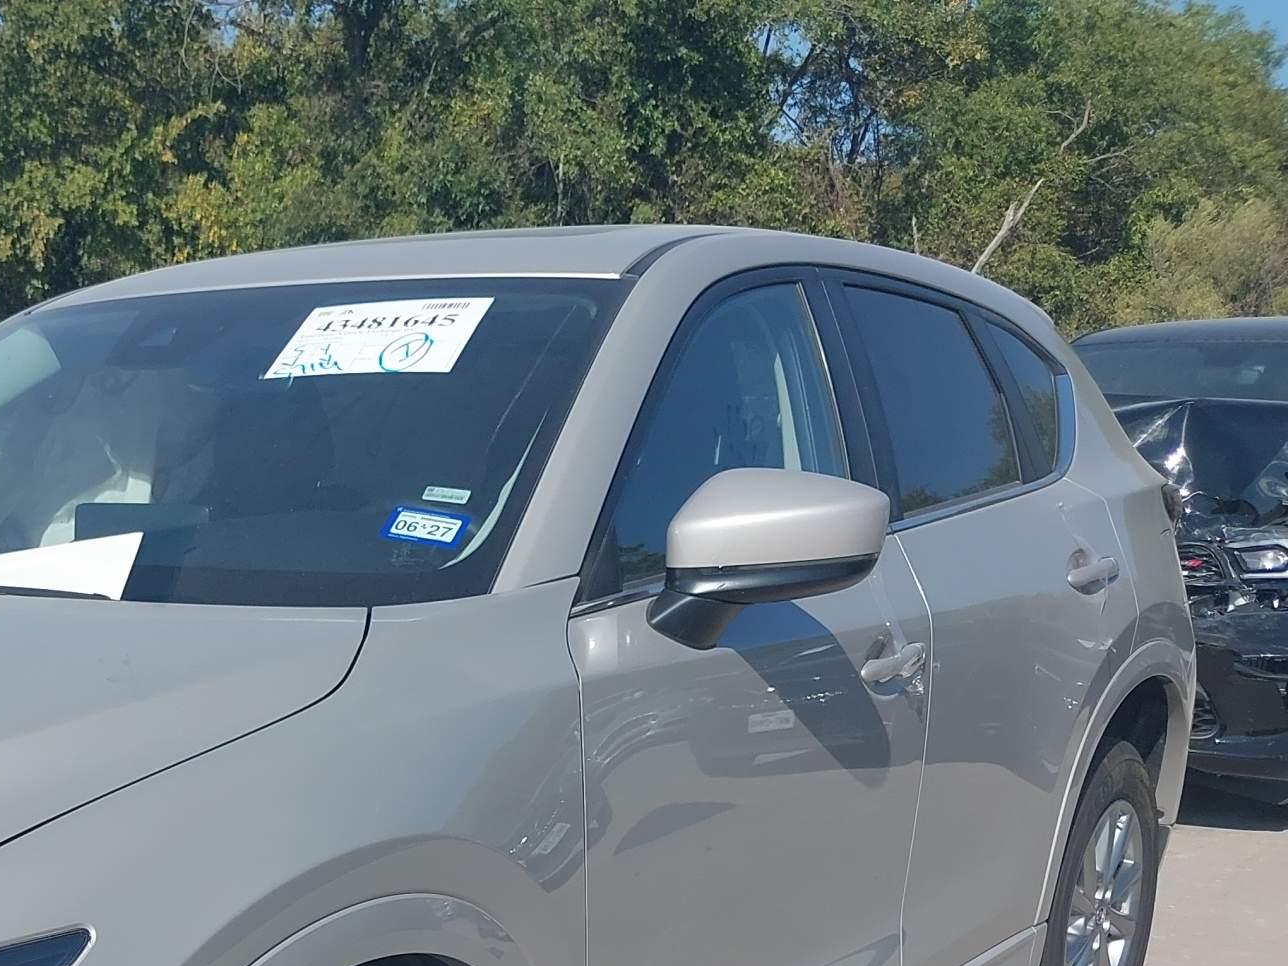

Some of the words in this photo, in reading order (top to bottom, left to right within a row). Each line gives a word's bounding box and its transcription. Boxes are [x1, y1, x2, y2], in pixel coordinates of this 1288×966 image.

[316, 314, 459, 332] 43481645
[395, 520, 418, 532] 06
[426, 525, 453, 537] 27
